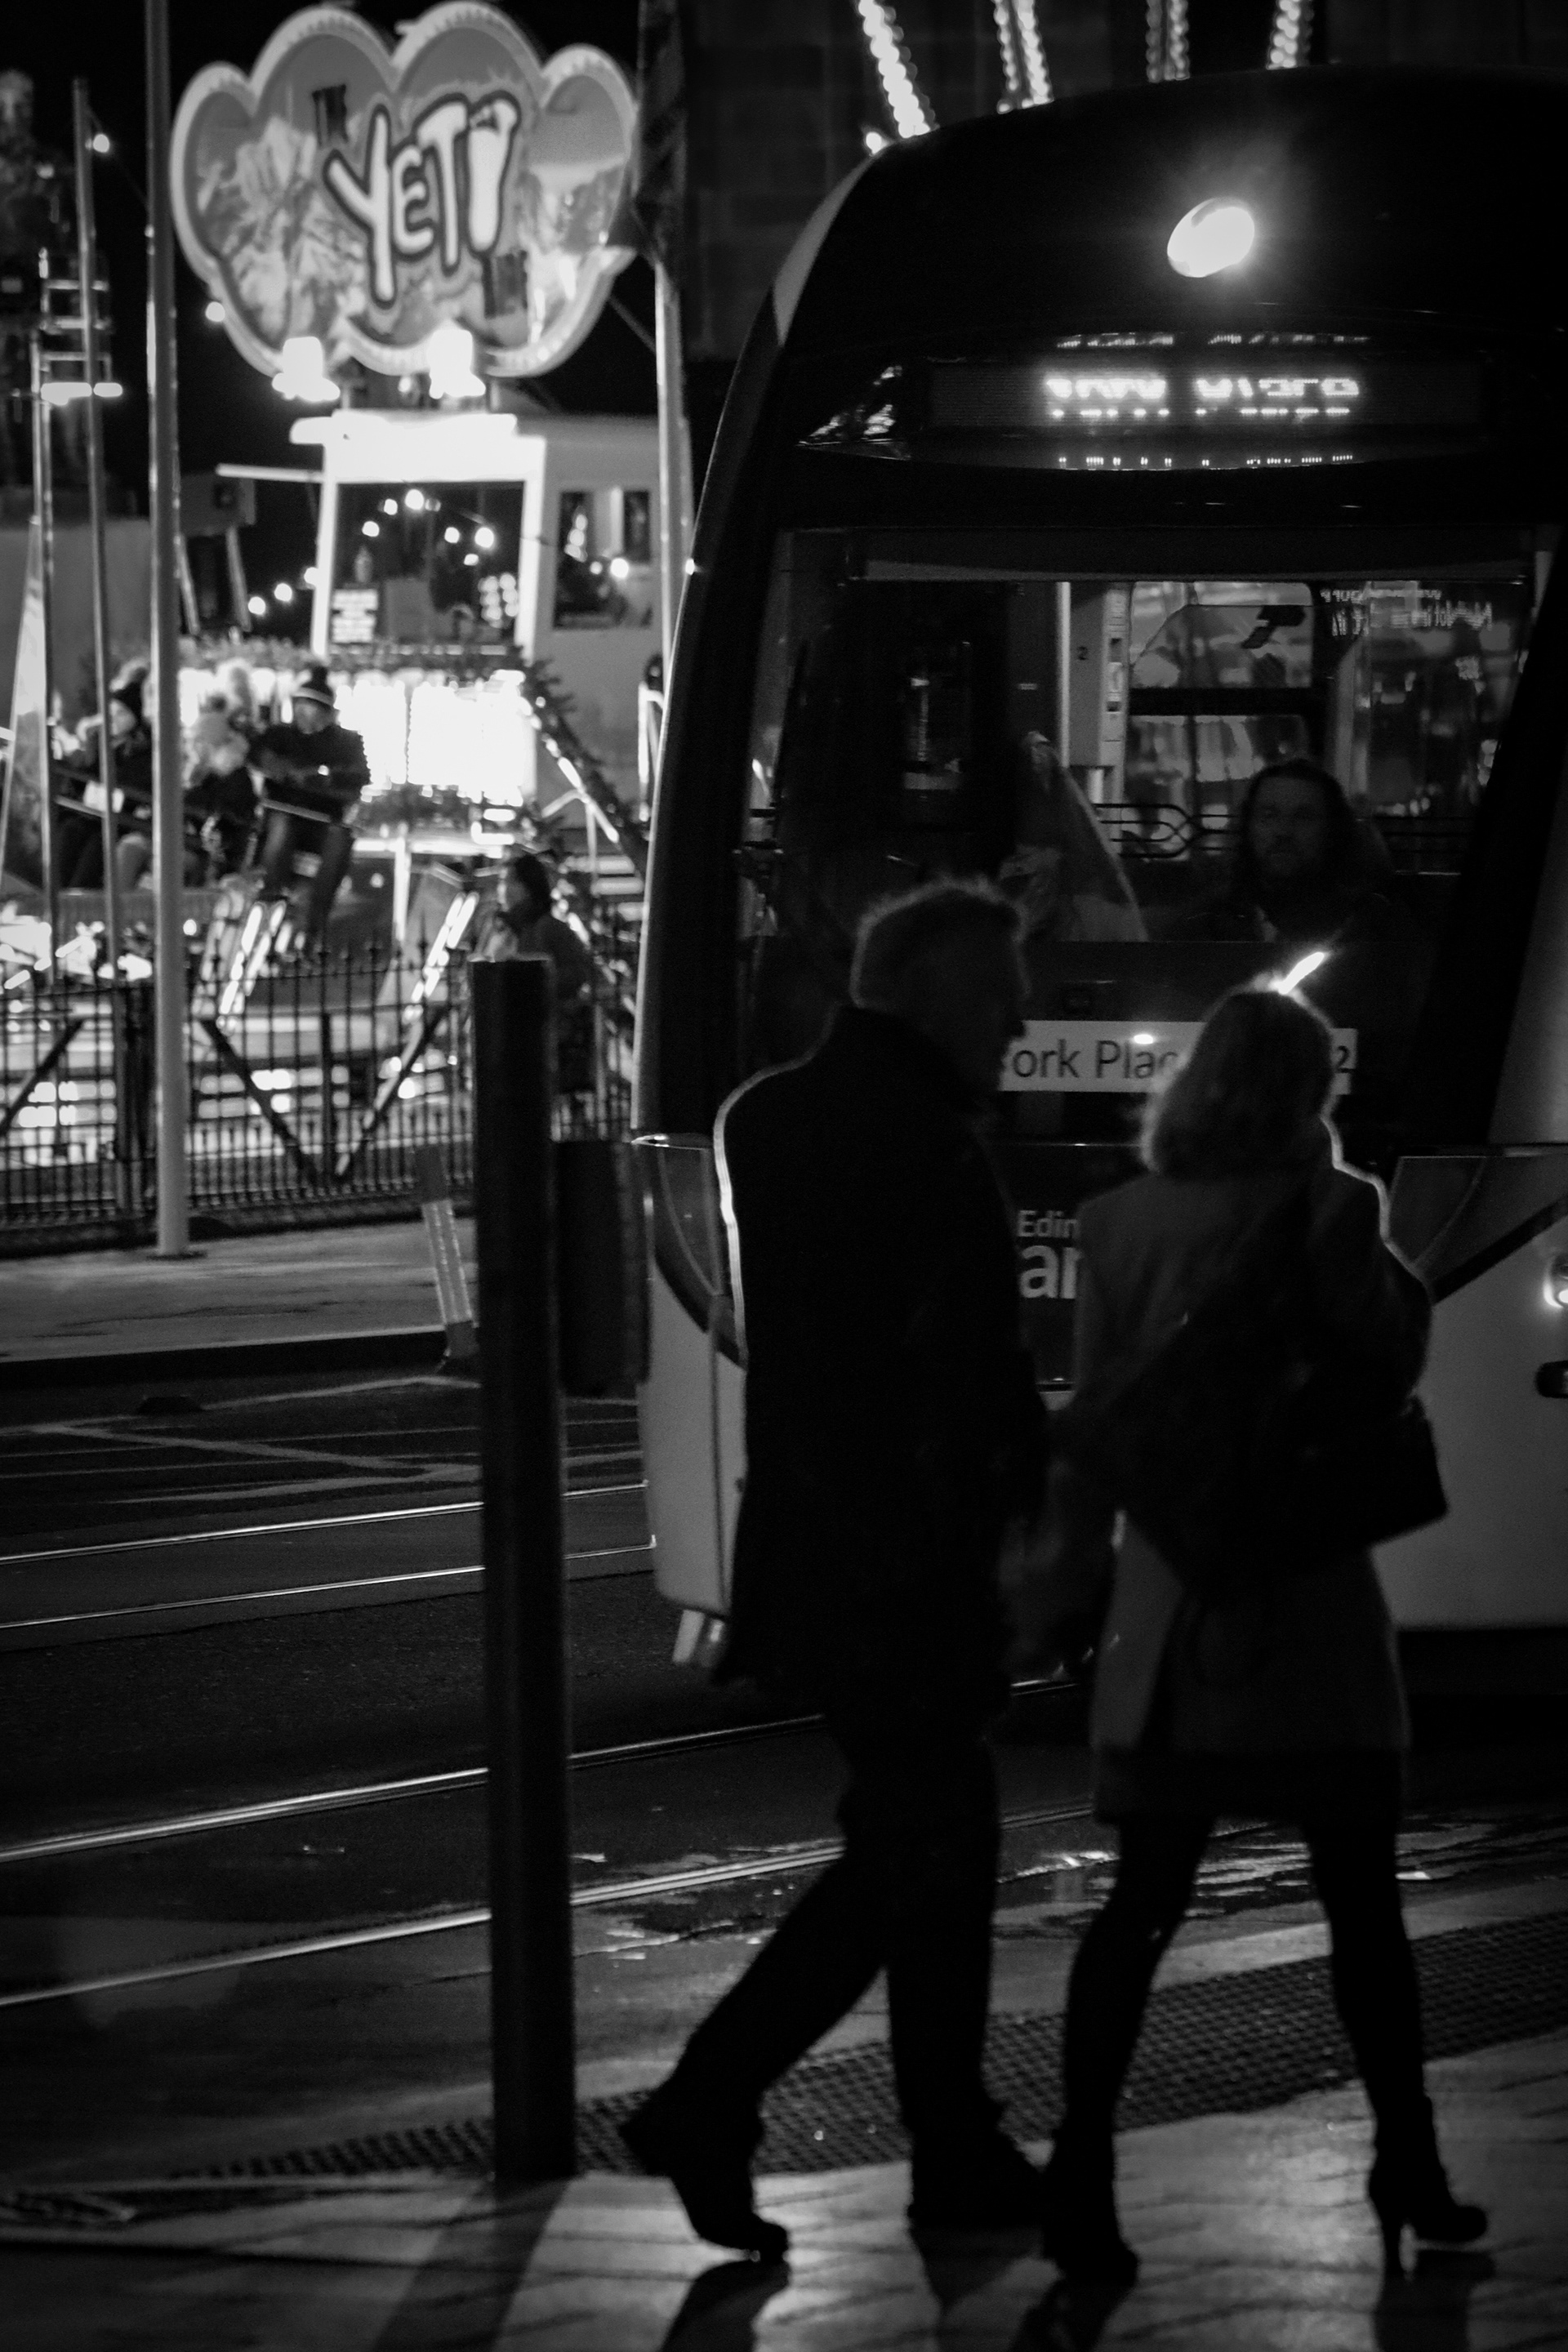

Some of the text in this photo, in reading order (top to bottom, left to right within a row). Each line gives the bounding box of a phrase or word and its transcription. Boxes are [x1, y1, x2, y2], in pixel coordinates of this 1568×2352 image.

[323, 90, 523, 309] YETI
[1011, 1039, 1178, 1079] ork Plac
[1018, 1209, 1080, 1238] Edin
